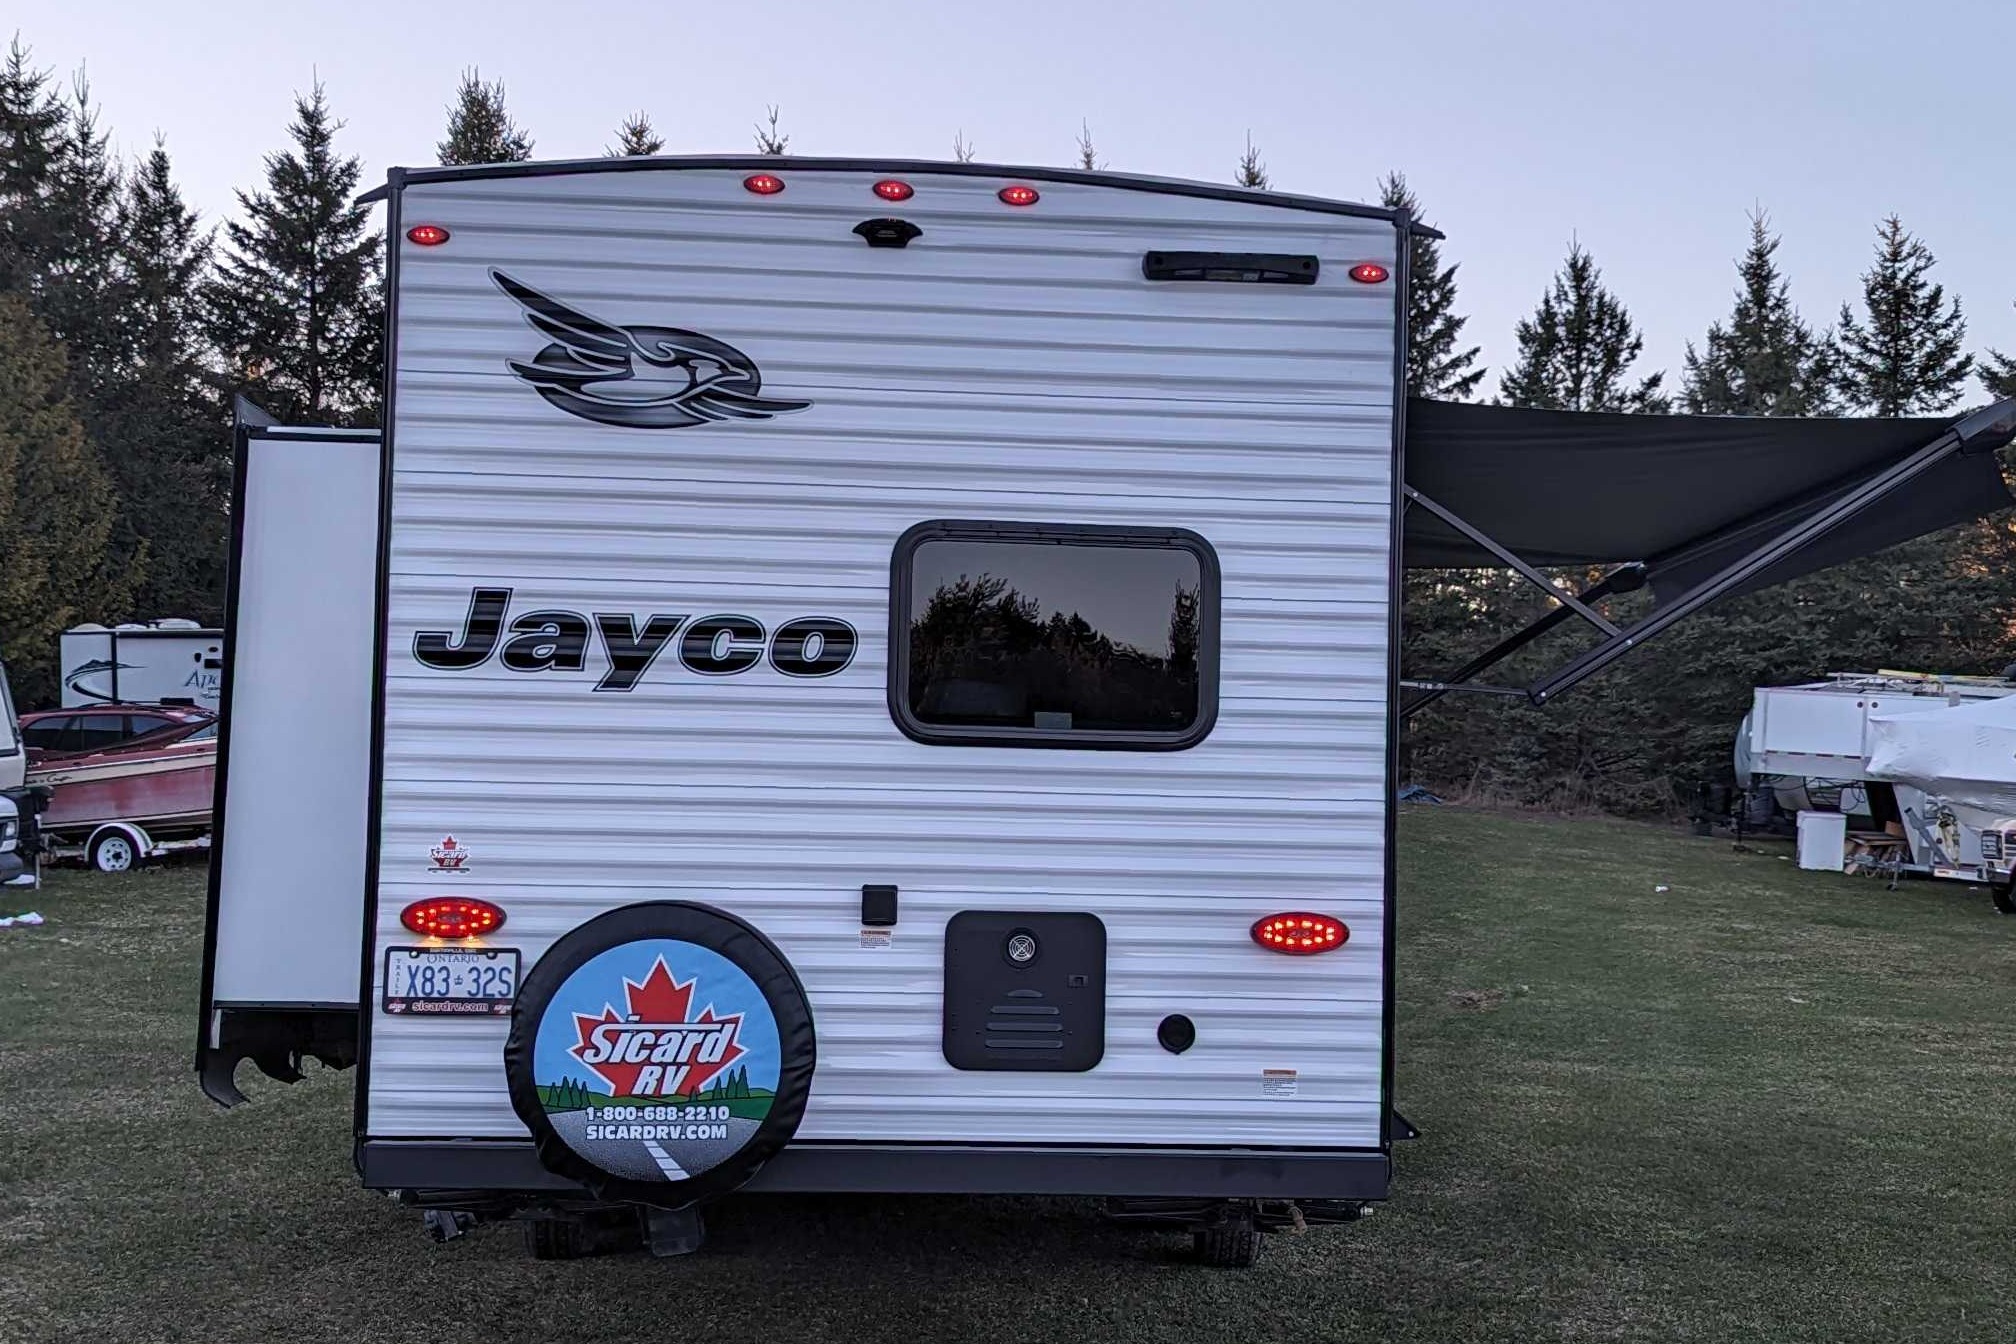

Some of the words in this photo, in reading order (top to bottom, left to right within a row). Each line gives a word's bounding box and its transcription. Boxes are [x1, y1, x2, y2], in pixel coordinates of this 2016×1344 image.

[412, 586, 859, 692] Jayco
[427, 953, 480, 964] ONTARIO
[406, 964, 451, 997] X83
[467, 966, 513, 997] 32S
[411, 1000, 489, 1012] sicardrv.com
[582, 1014, 736, 1064] Sicard
[631, 1065, 692, 1095] RV
[586, 1105, 730, 1121] 1-800-688-2210
[586, 1124, 728, 1140] SICARDRV.COM
